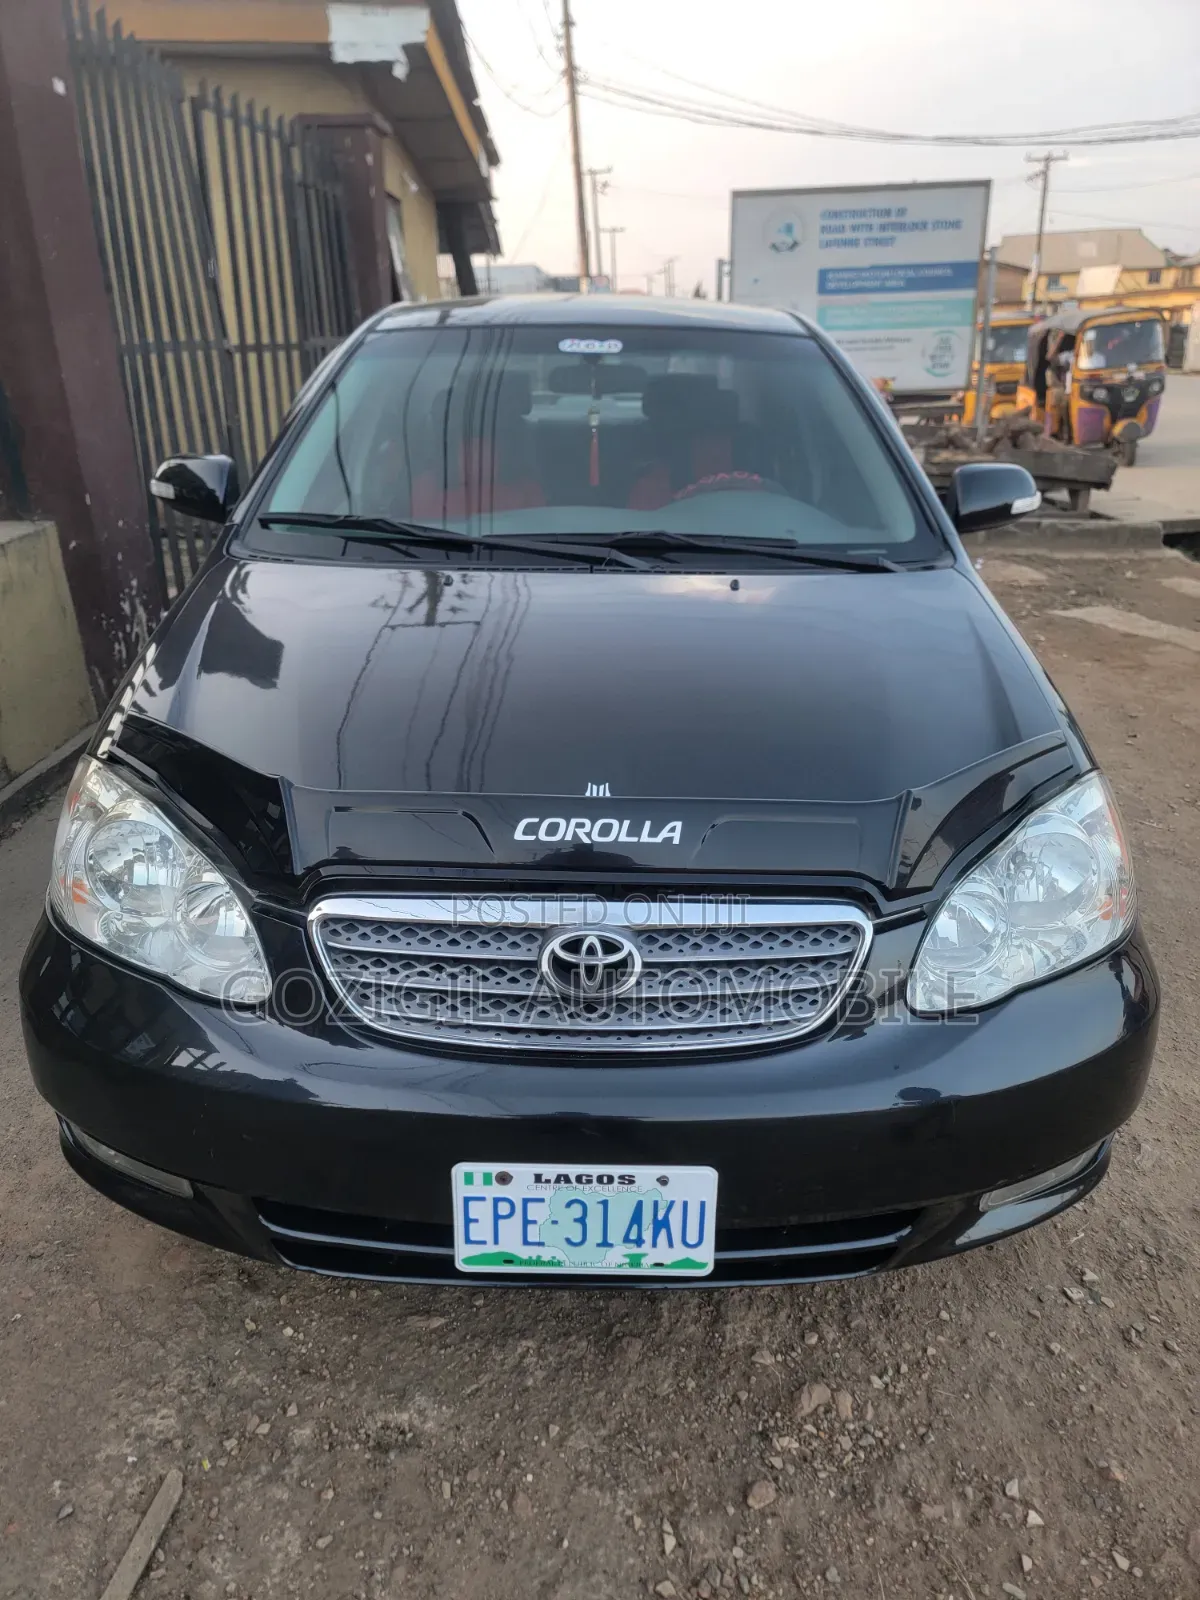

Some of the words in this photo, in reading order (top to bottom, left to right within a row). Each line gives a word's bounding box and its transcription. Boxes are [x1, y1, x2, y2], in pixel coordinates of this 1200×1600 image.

[513, 817, 683, 845] COROLLA
[533, 1173, 636, 1185] LAGOS
[526, 1184, 564, 1192] CENTRE
[582, 1185, 643, 1193] EXCELLENCE
